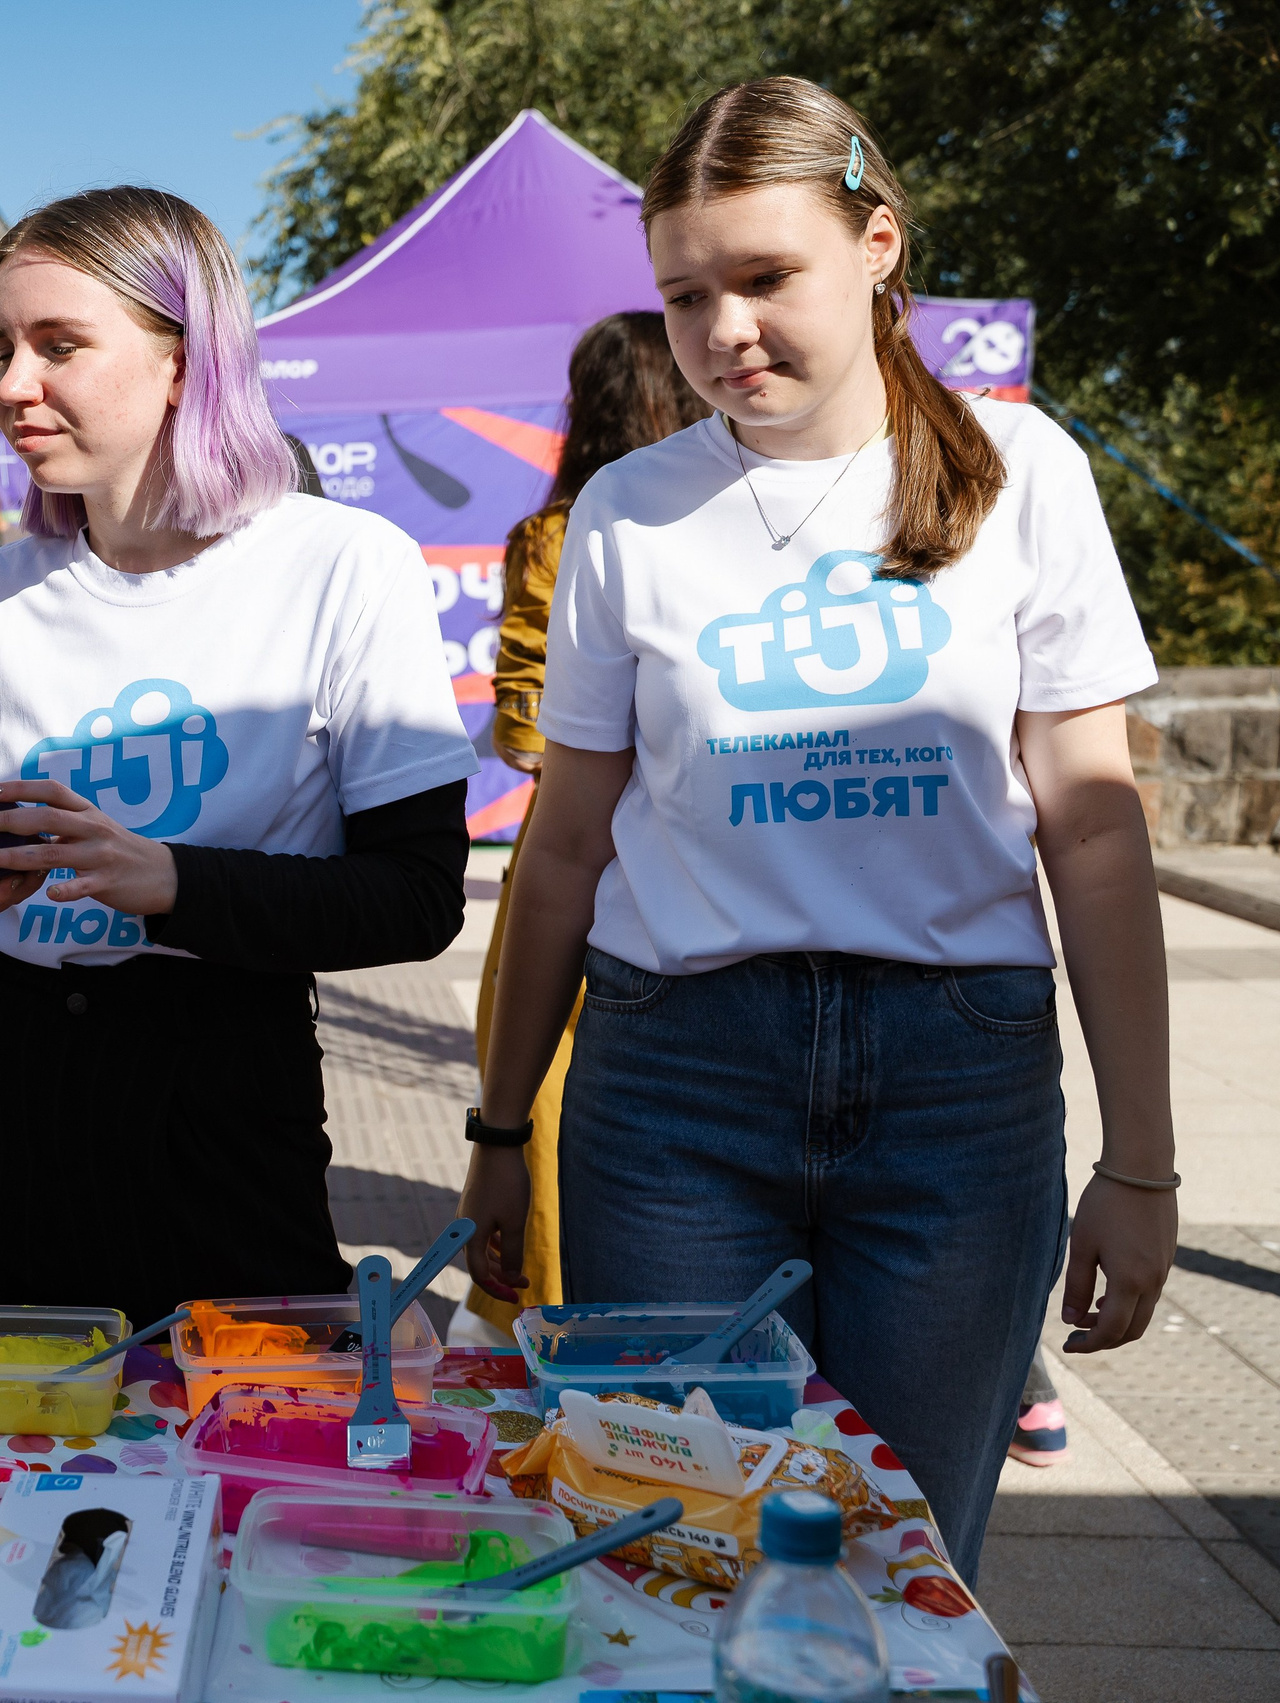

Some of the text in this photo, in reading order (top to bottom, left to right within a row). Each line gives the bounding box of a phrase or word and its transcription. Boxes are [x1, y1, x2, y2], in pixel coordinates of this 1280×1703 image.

[707, 730, 850, 755] ТЕЛЕКАНАЛ
[804, 751, 852, 771] ДЛЯ
[856, 748, 902, 767] ТЕХ,
[728, 774, 949, 827] ЛЮБЯТ
[19, 904, 154, 947] ЛЮБ
[599, 1418, 690, 1446] САЛФЕТКИ
[606, 1430, 693, 1458] ВЛАЖНЫЕ
[624, 1447, 688, 1473] 140 шт
[54, 1476, 79, 1487] S
[185, 1480, 207, 1508] WHITE
[688, 1530, 711, 1545] 140
[160, 1586, 181, 1618] GLOVES
